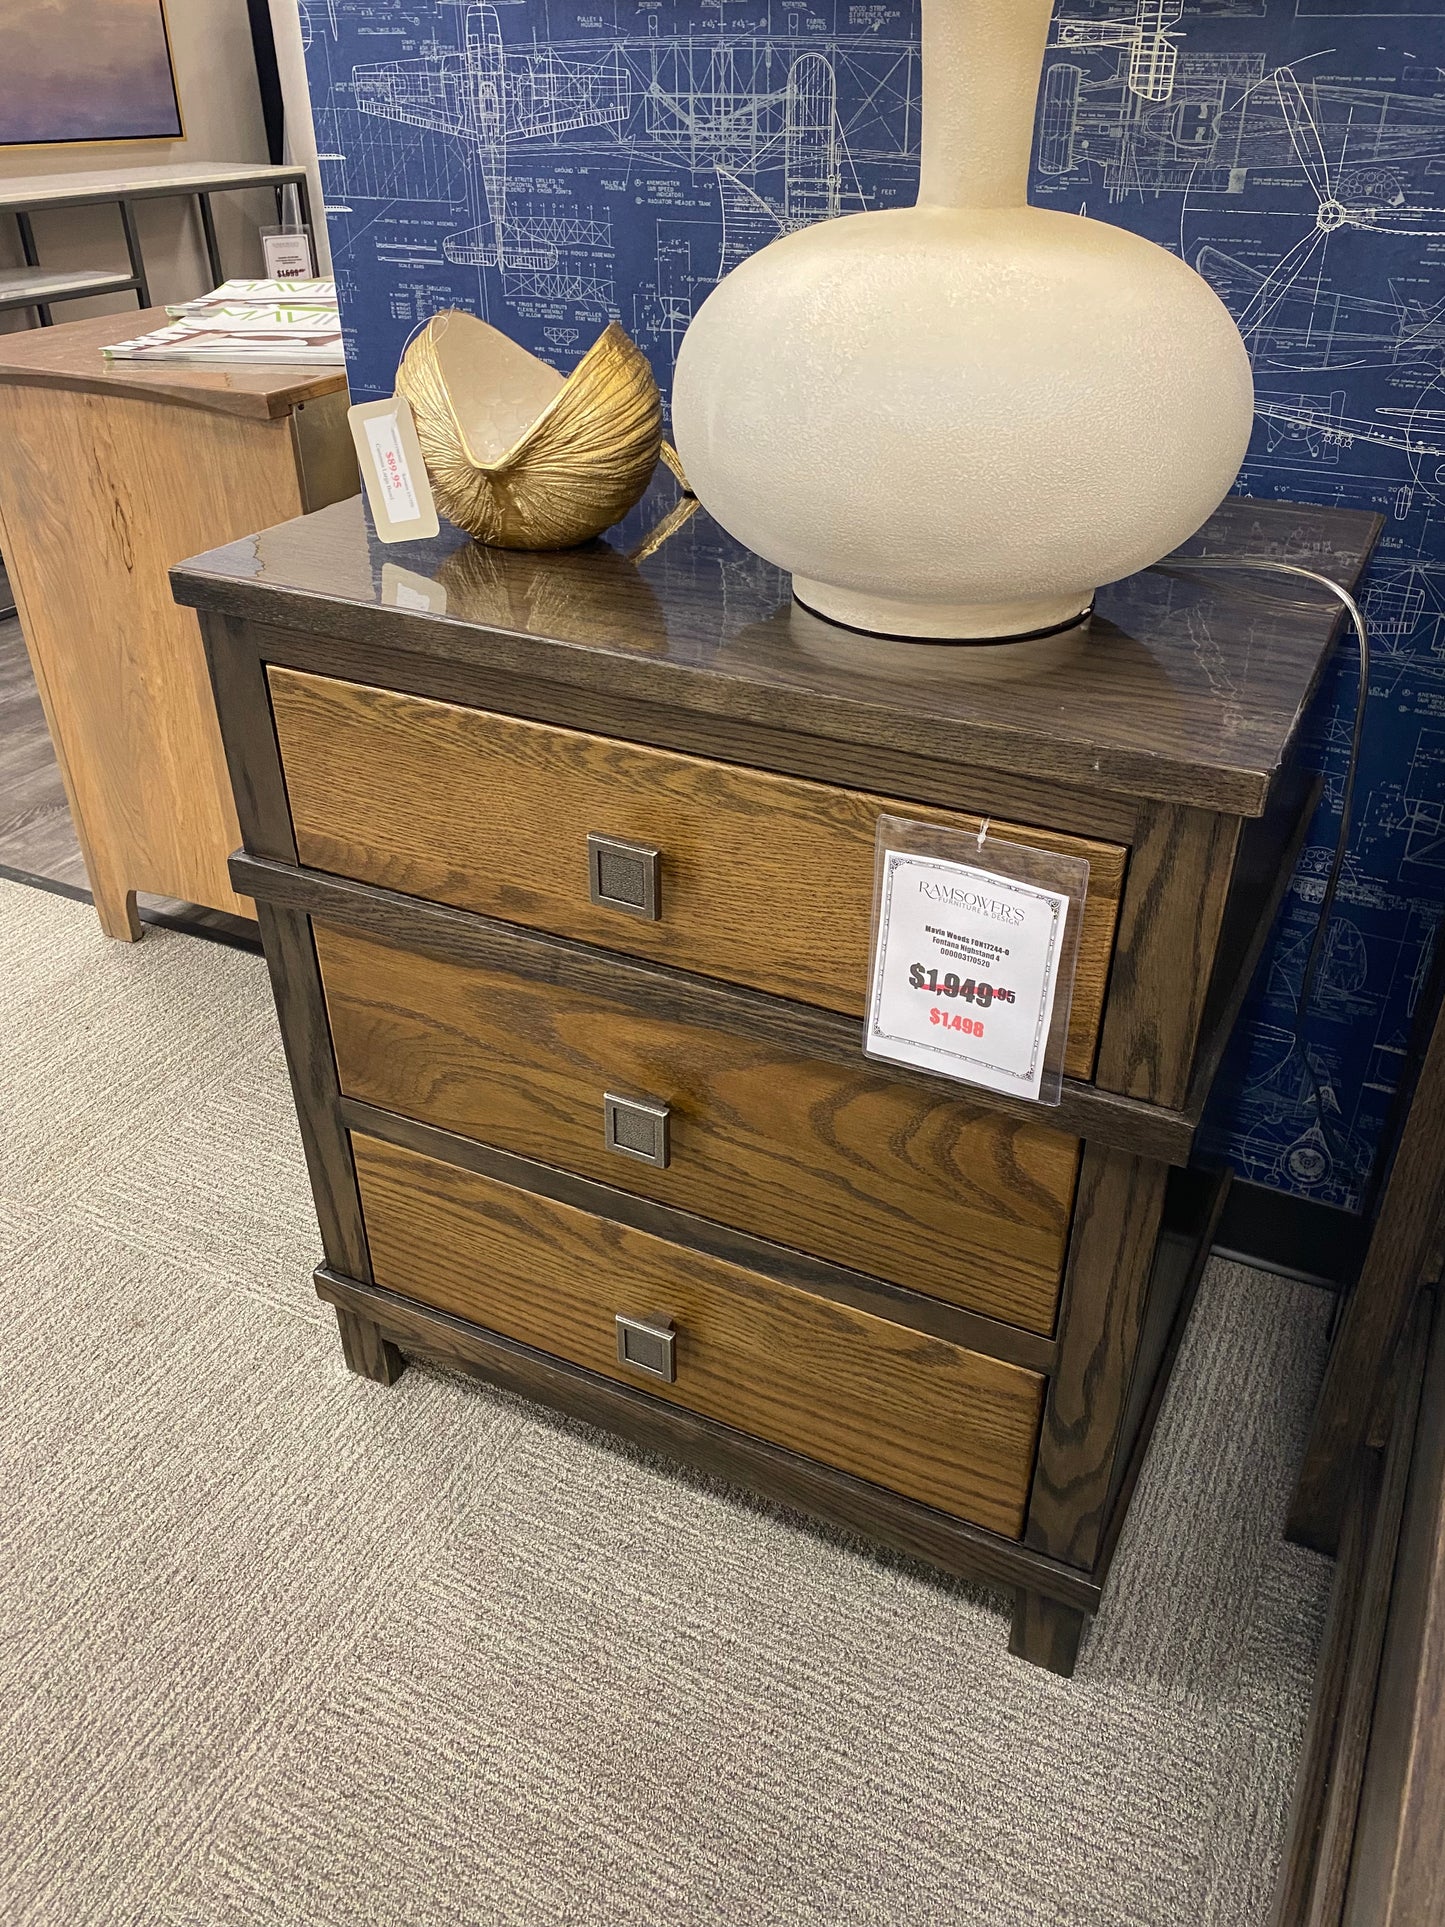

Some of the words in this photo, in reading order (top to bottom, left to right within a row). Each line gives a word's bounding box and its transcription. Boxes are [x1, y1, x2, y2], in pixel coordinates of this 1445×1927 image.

[385, 451, 402, 489] $89.95
[919, 881, 1025, 922] RAMSOWER'S
[938, 896, 981, 914] FURNITURE
[991, 912, 1020, 926] DESIGN
[925, 925, 946, 936] Mavin
[946, 931, 970, 944] Woods
[932, 936, 959, 950] Fontana
[940, 947, 991, 968] 000003170520
[908, 962, 1016, 1008] $1,949.95
[929, 1007, 985, 1038] $1,498
